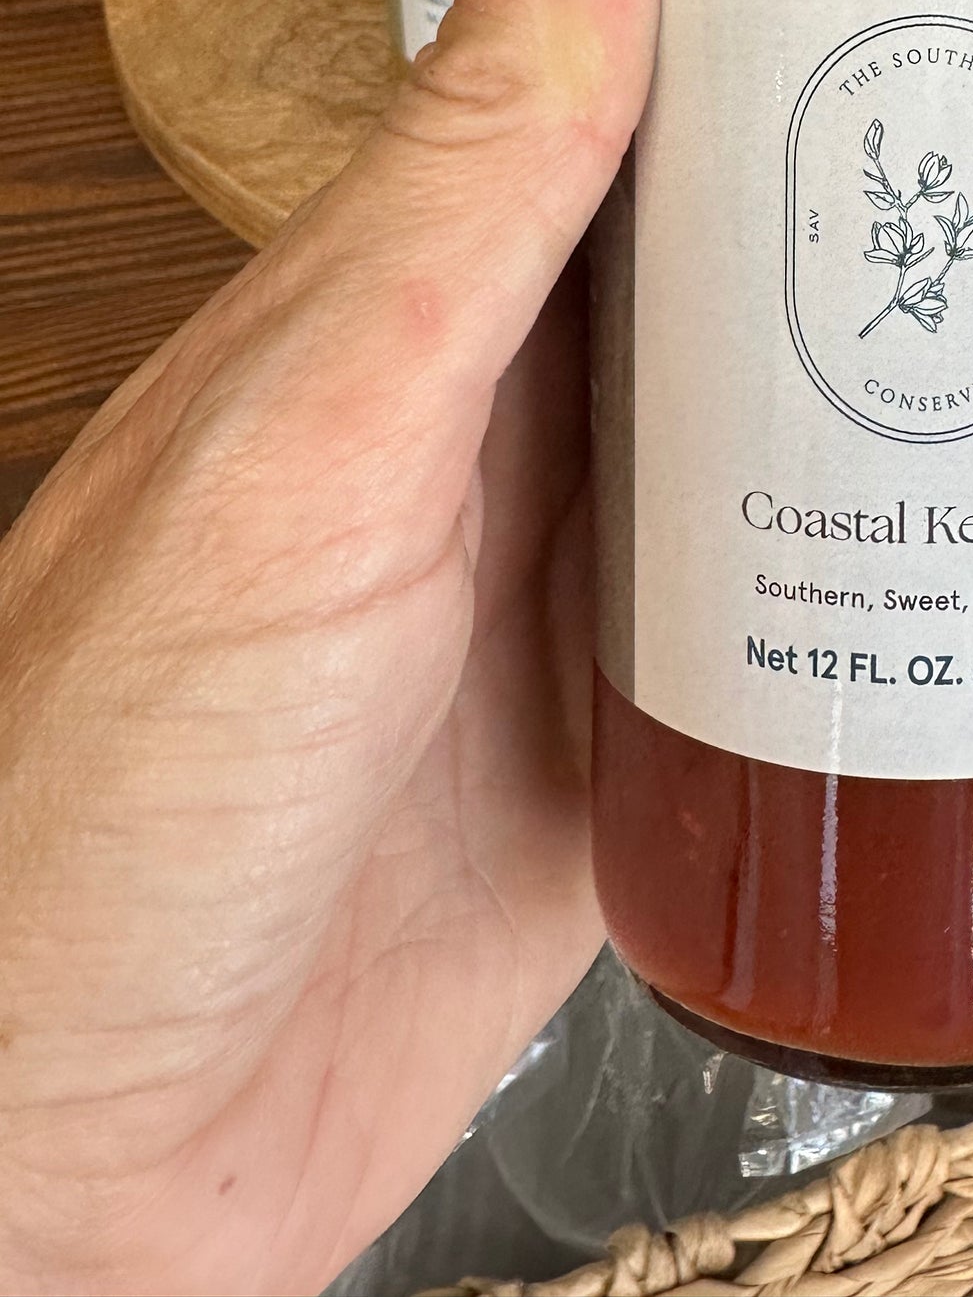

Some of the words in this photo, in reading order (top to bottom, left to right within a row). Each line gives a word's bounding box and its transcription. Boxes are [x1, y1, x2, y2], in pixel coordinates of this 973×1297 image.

[839, 60, 882, 97] THE
[808, 208, 820, 244] SAV
[742, 491, 908, 544] Coastal
[755, 574, 874, 612] Southern,
[883, 589, 969, 613] Sweet,
[747, 634, 798, 675] Net
[808, 648, 838, 680] 12
[850, 652, 897, 685] FL.
[907, 655, 963, 686] OZ.
